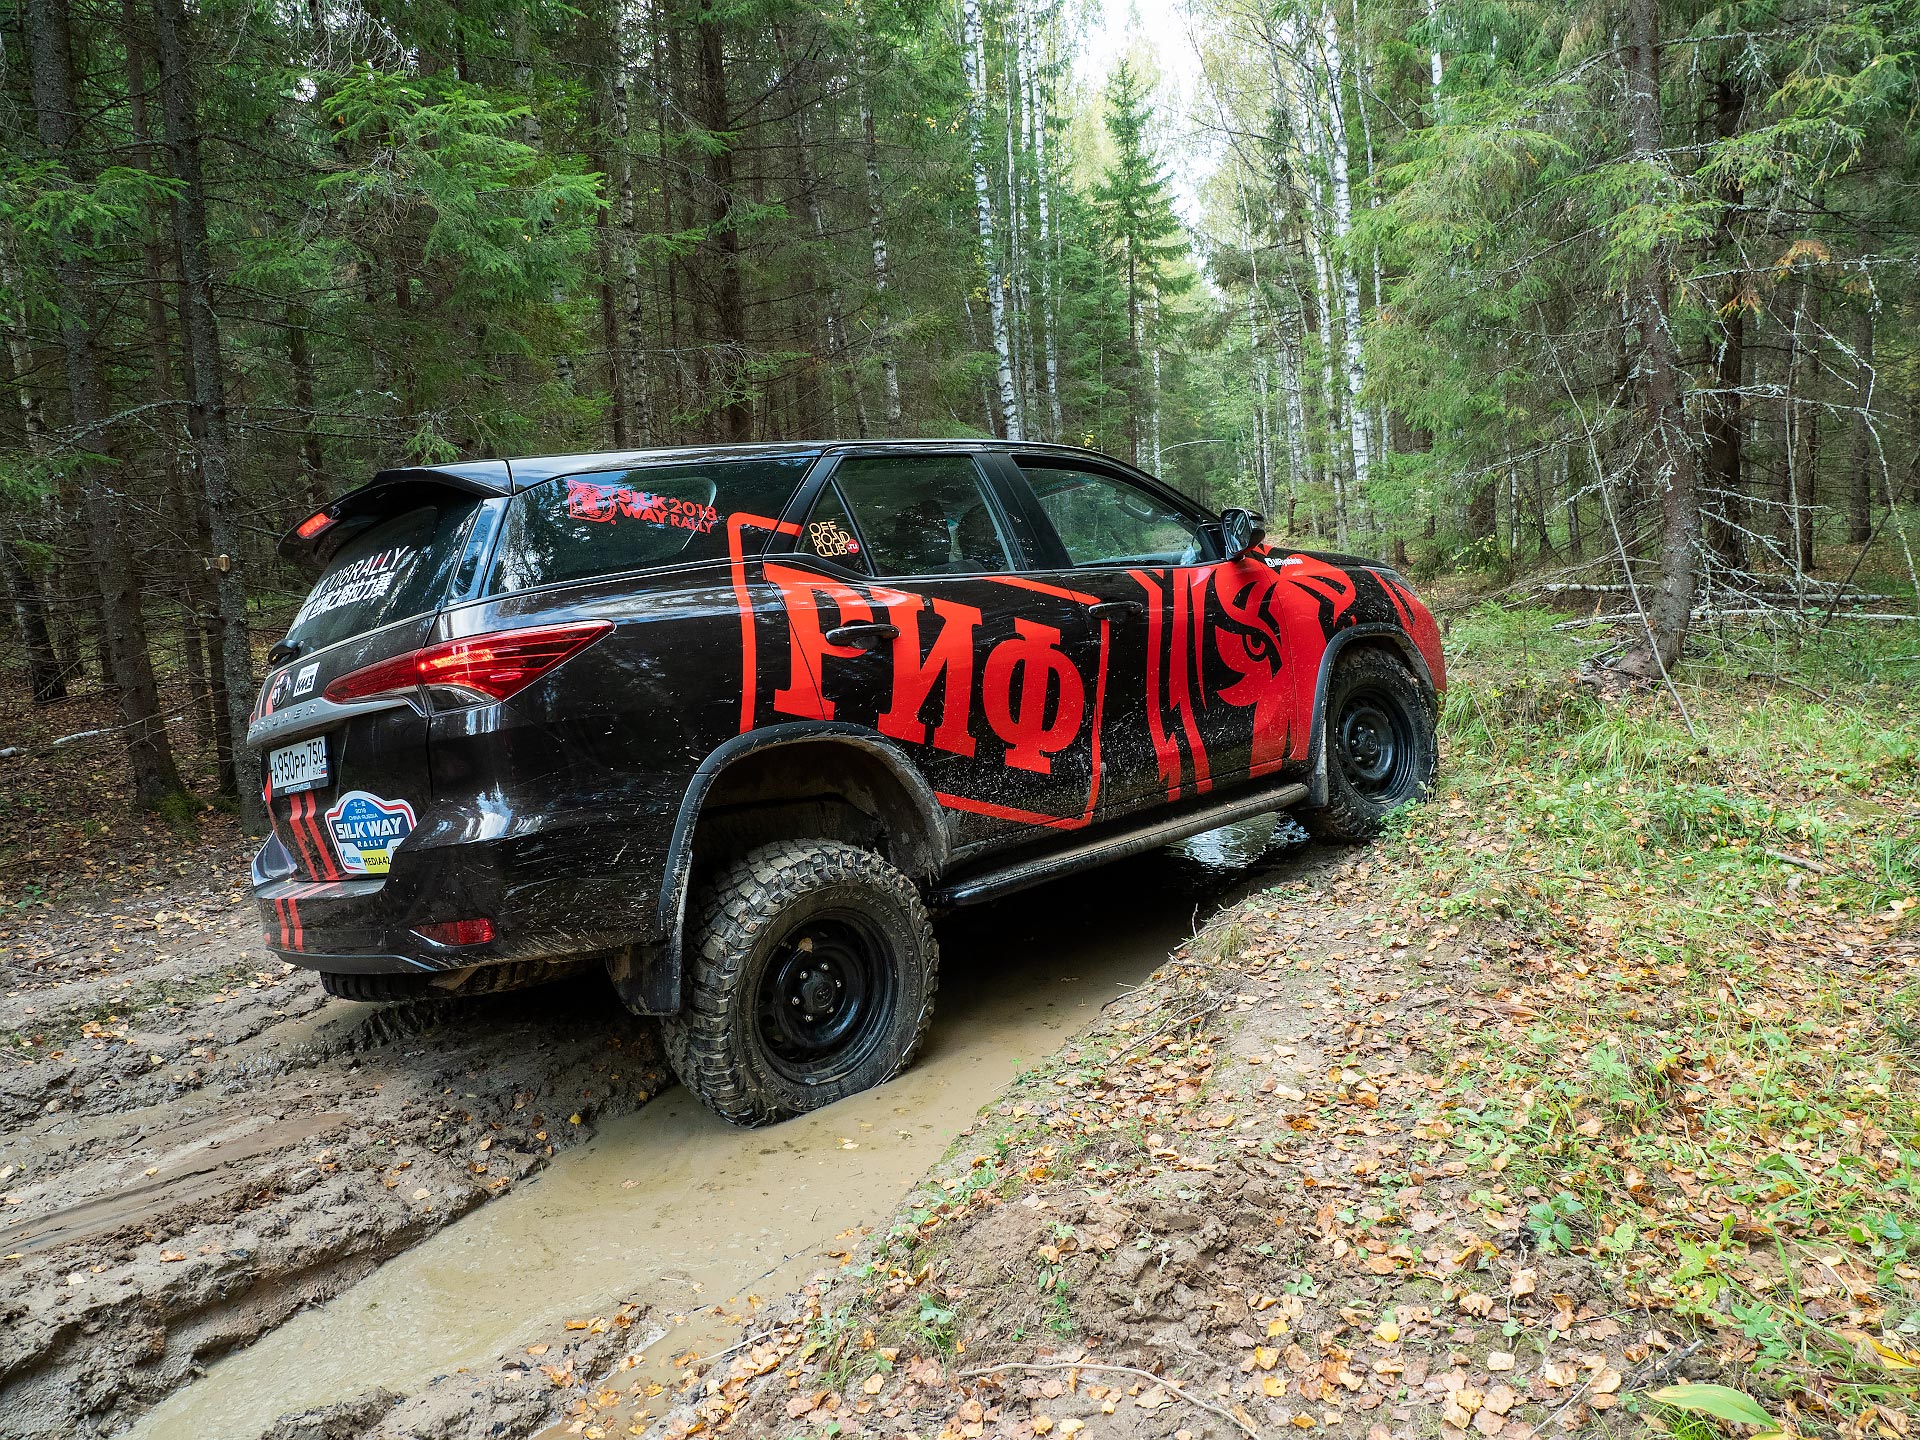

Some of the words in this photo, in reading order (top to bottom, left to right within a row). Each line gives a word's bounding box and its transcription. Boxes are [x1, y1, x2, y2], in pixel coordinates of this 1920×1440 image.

[617, 489, 668, 512] SILK
[669, 497, 718, 521] 2018
[619, 502, 668, 525] WAY
[670, 514, 714, 534] RALLY
[808, 520, 838, 535] OFF
[811, 530, 851, 547] ROAD
[816, 542, 848, 557] CLUB
[763, 562, 1085, 775] РИФ
[307, 740, 324, 767] 750
[335, 821, 368, 840] SILK
[366, 816, 403, 838] WAY
[357, 839, 384, 848] RALLY
